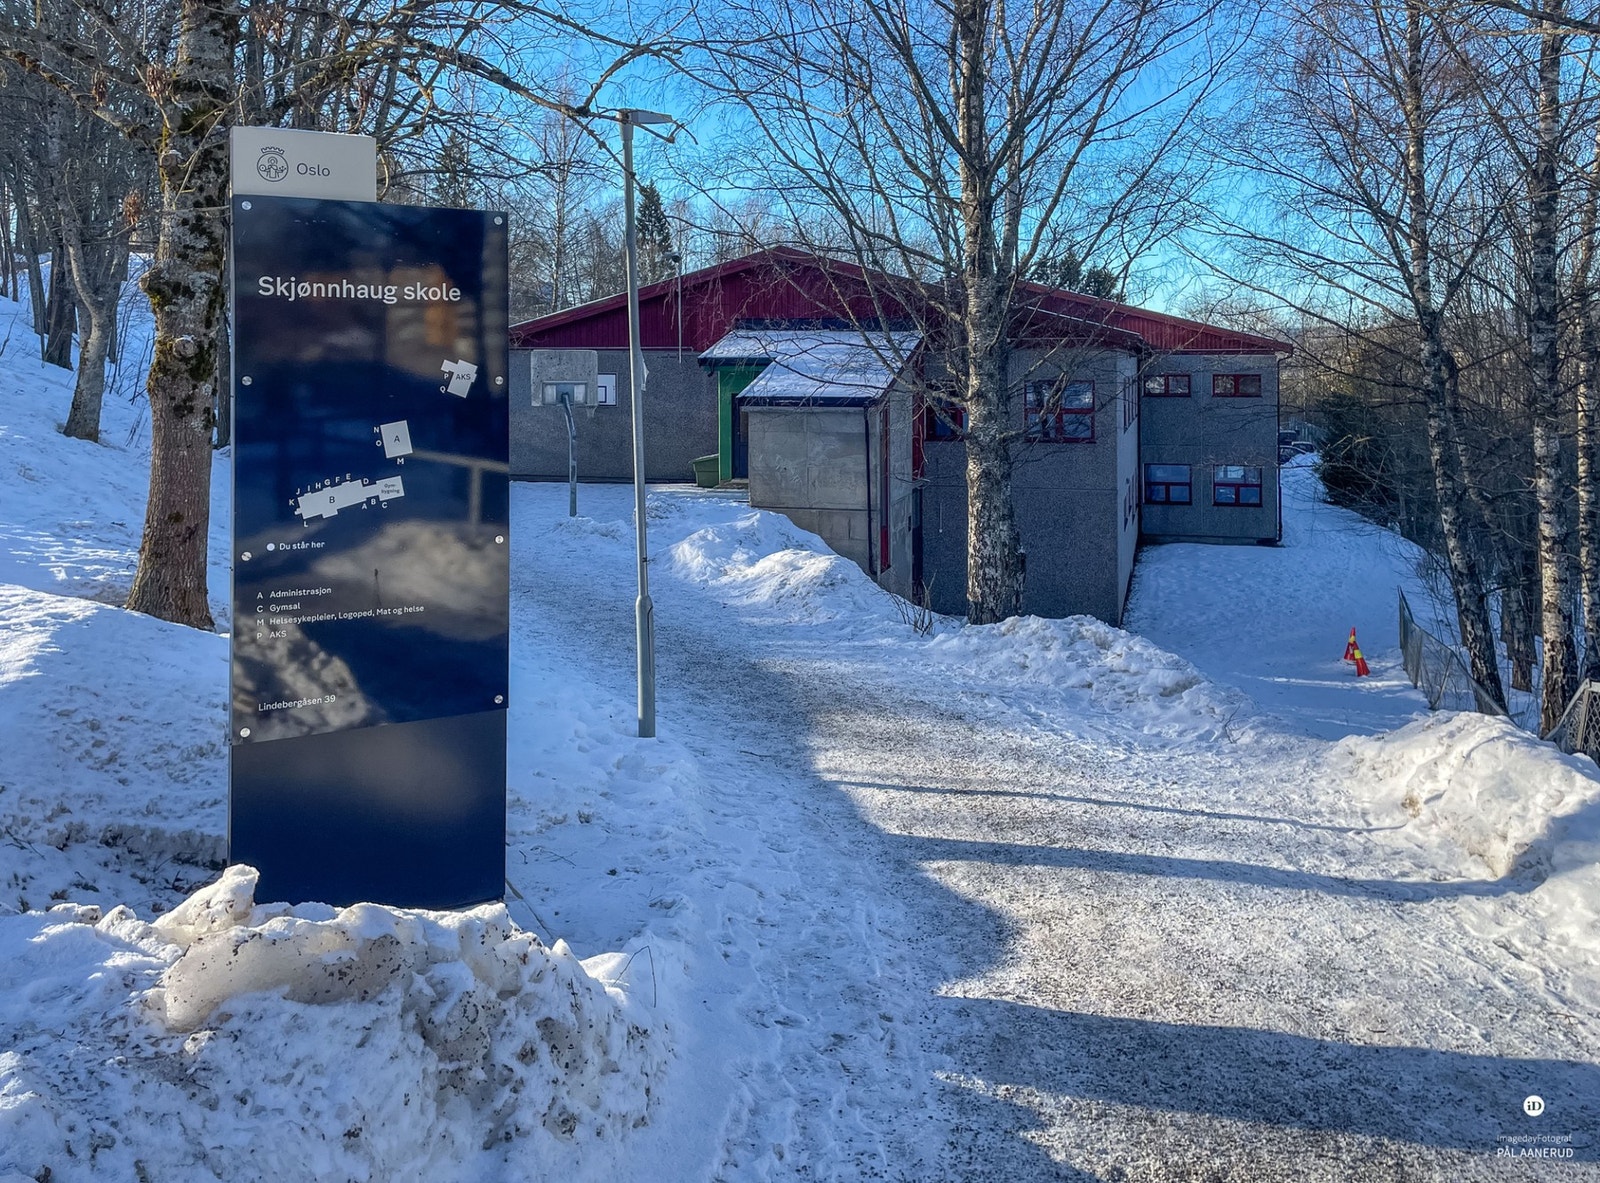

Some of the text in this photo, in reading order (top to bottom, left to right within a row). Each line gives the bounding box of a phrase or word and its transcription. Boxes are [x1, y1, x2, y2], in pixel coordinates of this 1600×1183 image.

[297, 163, 330, 177] Oslo
[258, 276, 461, 304] Skjønnhaug skole
[455, 373, 471, 381] AKS
[394, 435, 400, 443] A
[269, 587, 331, 598] Administrasjon
[269, 603, 301, 612] Gymsal
[269, 613, 337, 626] Helsesykepleier,
[338, 609, 375, 619] Logoped,
[270, 630, 287, 638] AKS
[258, 694, 336, 711] Lindebergåsen 39
